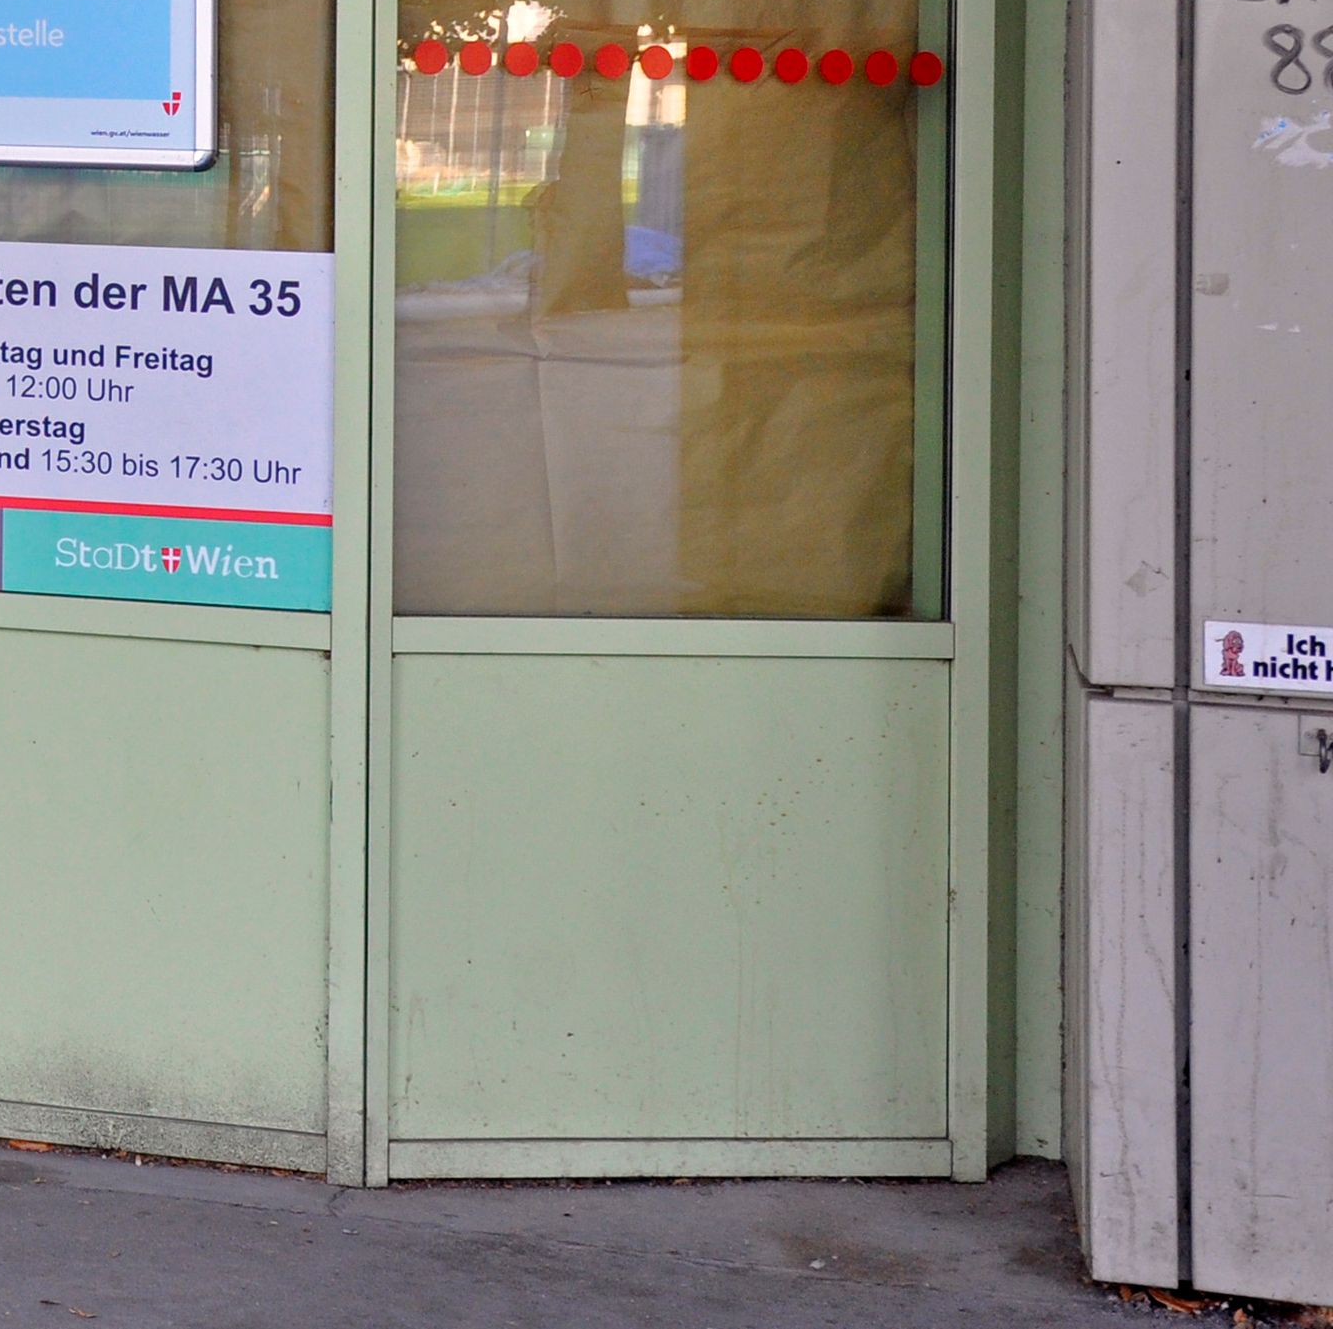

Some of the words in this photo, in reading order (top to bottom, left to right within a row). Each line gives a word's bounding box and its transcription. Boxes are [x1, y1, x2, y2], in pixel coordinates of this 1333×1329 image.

[73, 272, 146, 312] der
[162, 276, 235, 315] MA
[249, 279, 302, 318] 35
[52, 343, 104, 369] und
[116, 346, 214, 377] Freitag
[7, 375, 77, 401] 12:00
[87, 378, 135, 404] Uhr
[41, 449, 113, 476] 15:30
[122, 452, 159, 479] bis
[170, 456, 243, 482] 17:30
[253, 458, 302, 486] Uhr
[186, 547, 279, 580] Wien
[1286, 634, 1326, 657] Ich
[1253, 656, 1318, 681] nicht
